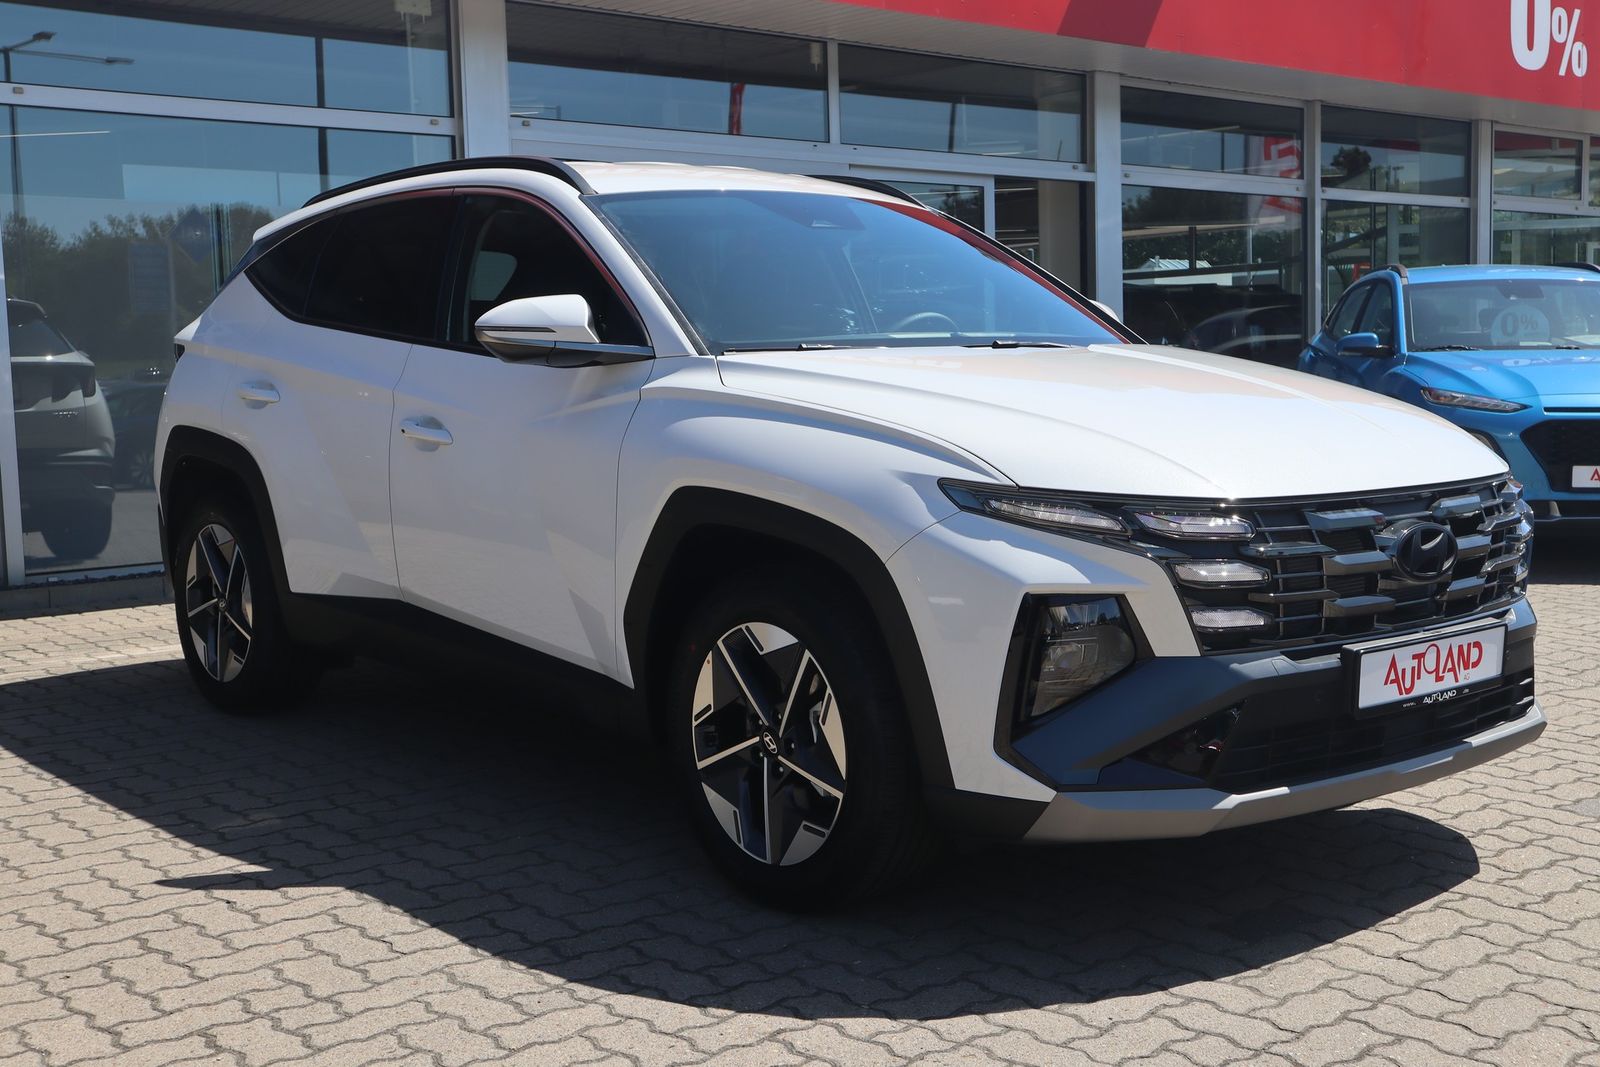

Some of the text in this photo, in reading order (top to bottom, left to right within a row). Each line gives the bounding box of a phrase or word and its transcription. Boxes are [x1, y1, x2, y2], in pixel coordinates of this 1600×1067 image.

[1510, 0, 1588, 78] 0%
[1501, 312, 1538, 336] 0%
[1384, 640, 1483, 696] AUTOLAND
